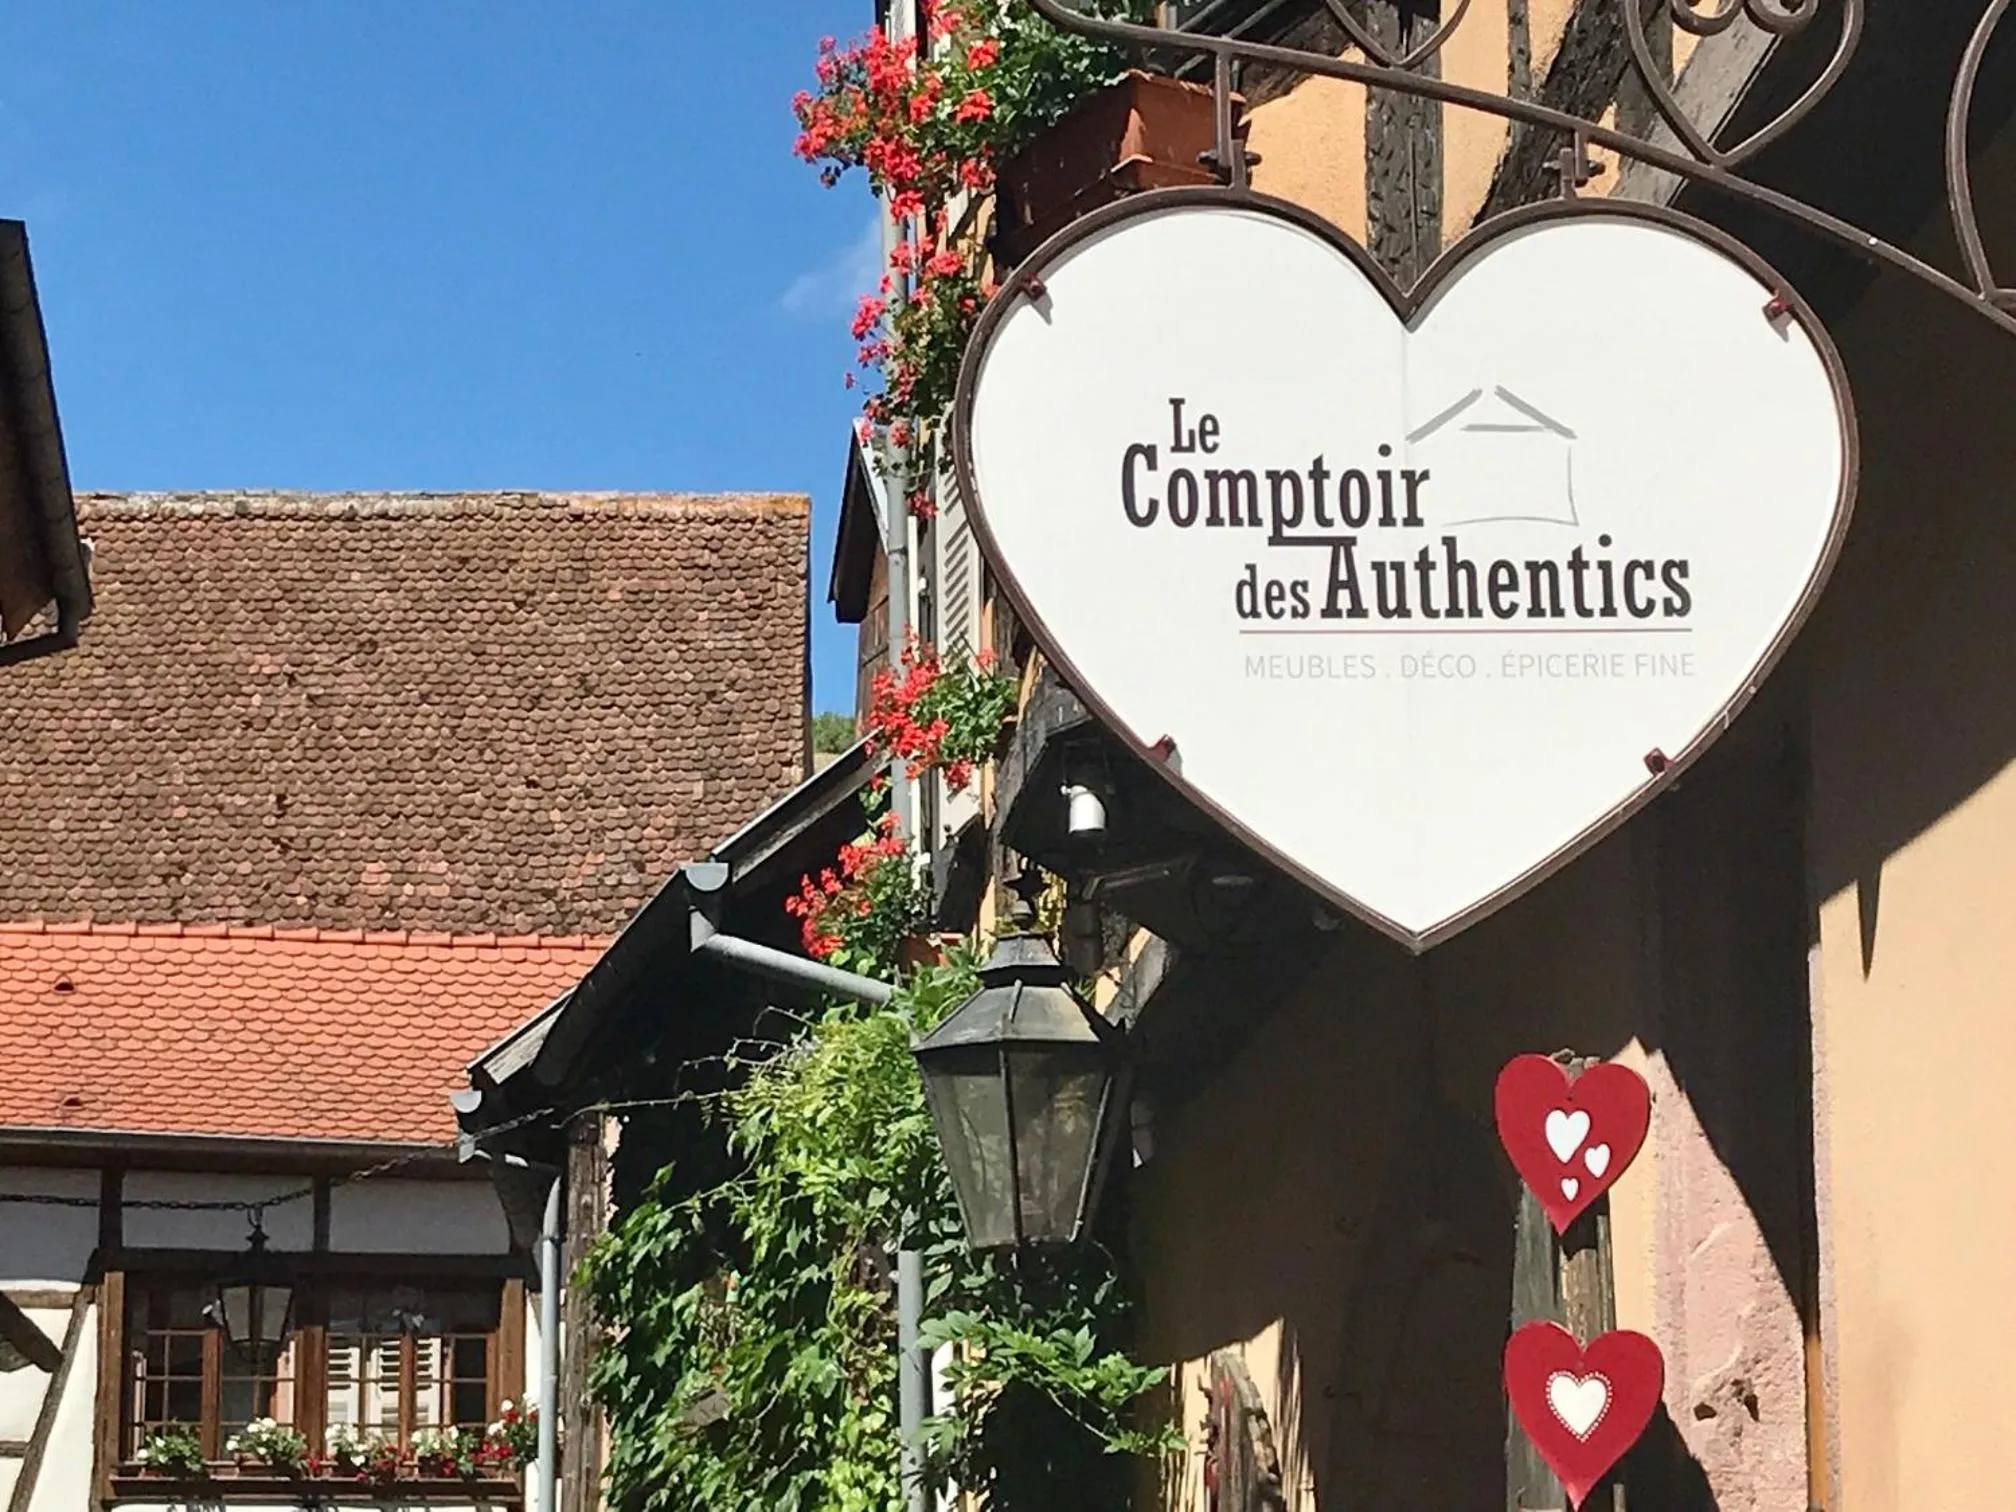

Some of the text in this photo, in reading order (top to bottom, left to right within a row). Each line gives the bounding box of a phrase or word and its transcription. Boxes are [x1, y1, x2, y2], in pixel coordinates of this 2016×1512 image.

[1169, 397, 1220, 453] Le
[1121, 443, 1431, 546] Comptoir
[1235, 535, 1693, 619] des Authentics
[1244, 655, 1377, 680] MEUBLES
[1401, 650, 1477, 679] DÉCO
[1501, 650, 1625, 679] ÉPICERIE
[1635, 654, 1696, 678] FINE
